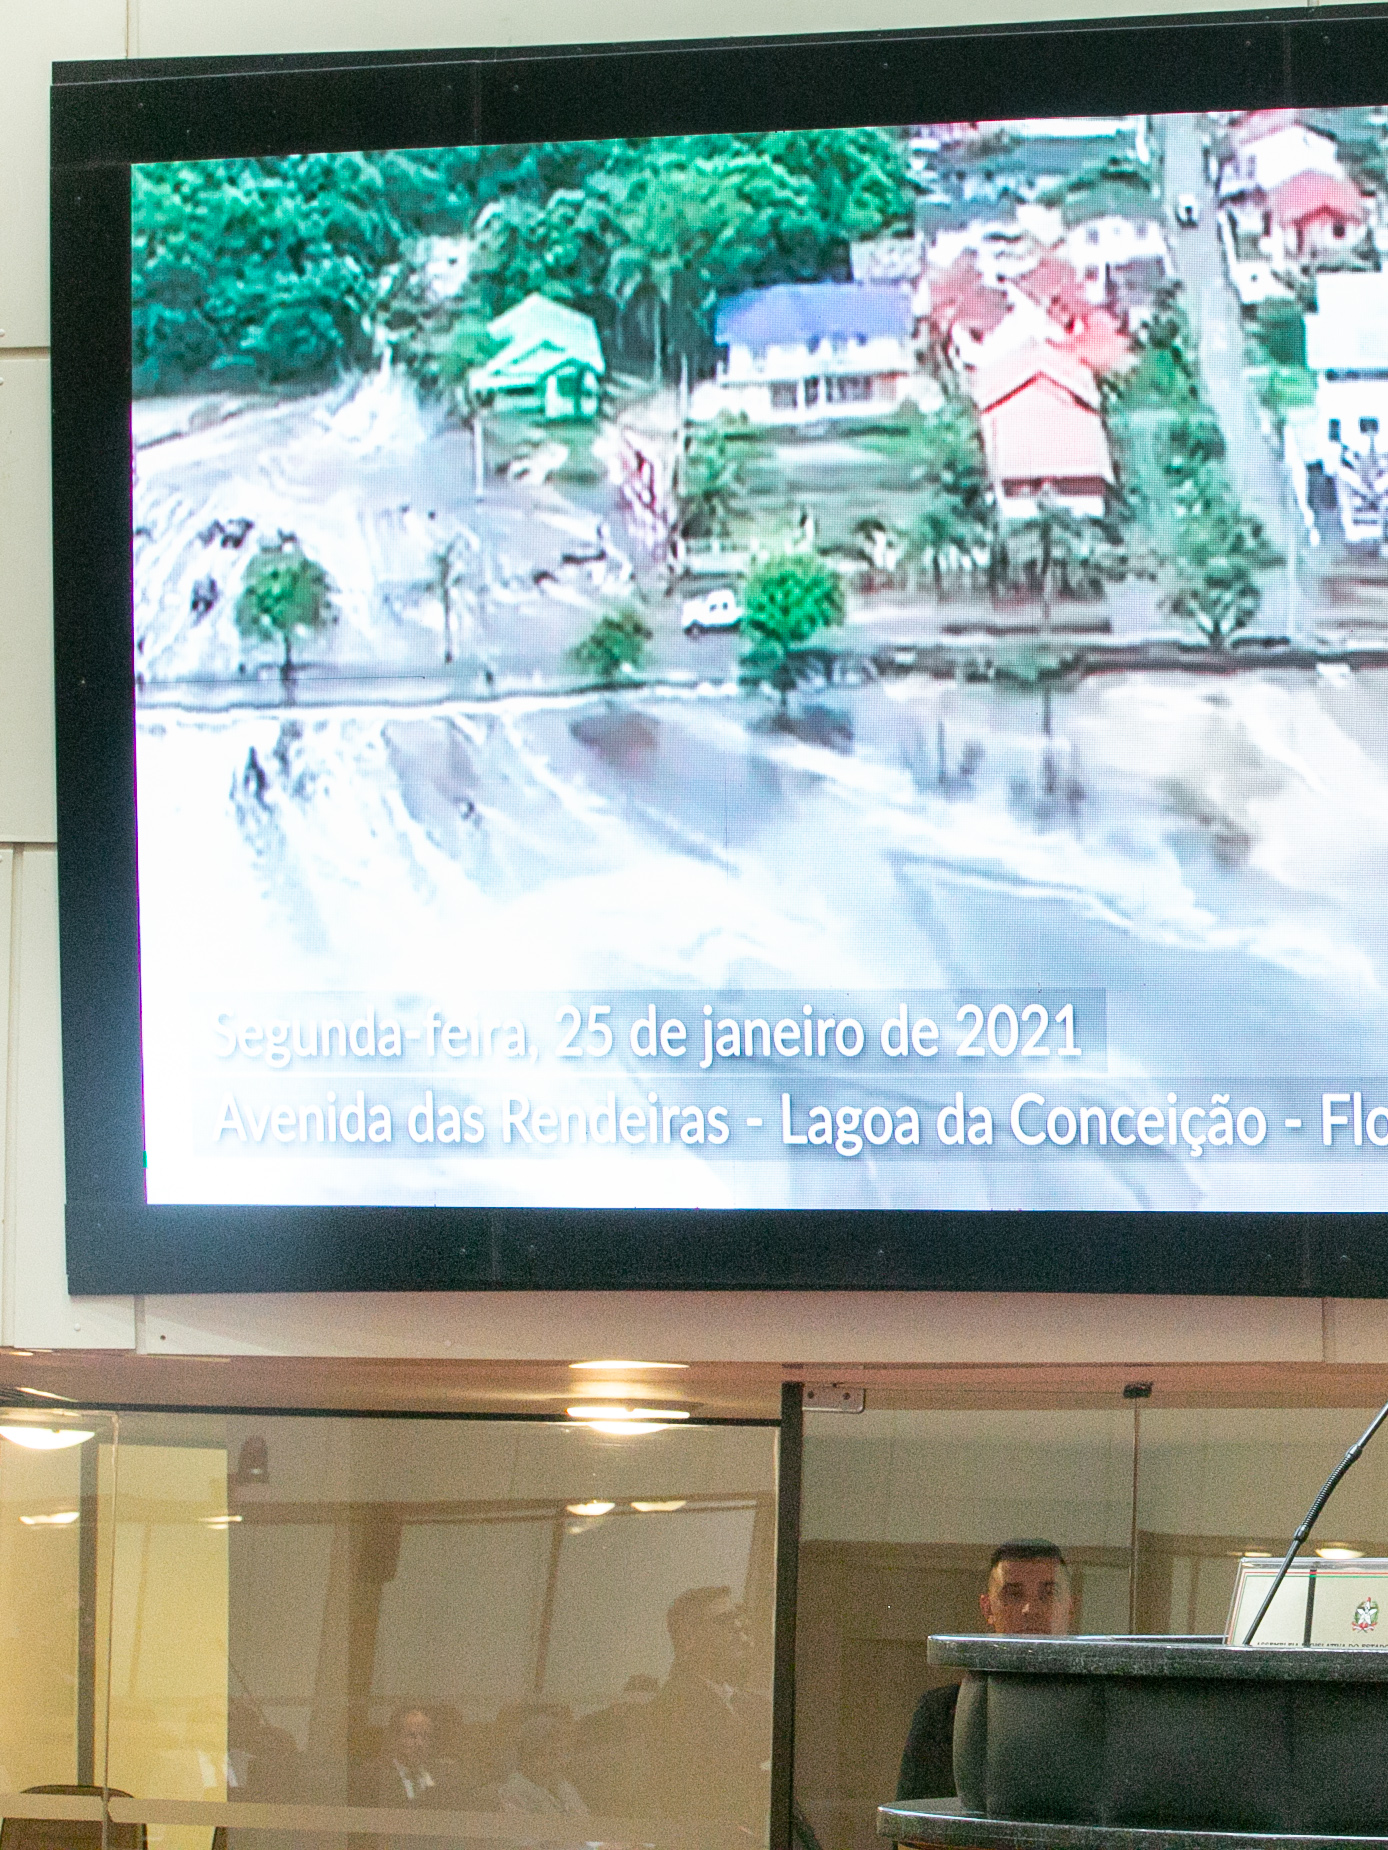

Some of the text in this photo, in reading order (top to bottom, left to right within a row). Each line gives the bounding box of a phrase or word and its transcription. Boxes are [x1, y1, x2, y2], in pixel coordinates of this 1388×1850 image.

[210, 1003, 1082, 1068] Segunda-feira, 25 de janeiro de 2021
[212, 1089, 393, 1144] Avenida
[407, 1089, 486, 1145] das
[502, 1090, 731, 1145] Rendeiras
[746, 1116, 763, 1128] -
[781, 1092, 921, 1157] Lagoa
[936, 1091, 994, 1146] da
[1010, 1091, 1268, 1157] Conceição
[1284, 1117, 1302, 1129] -
